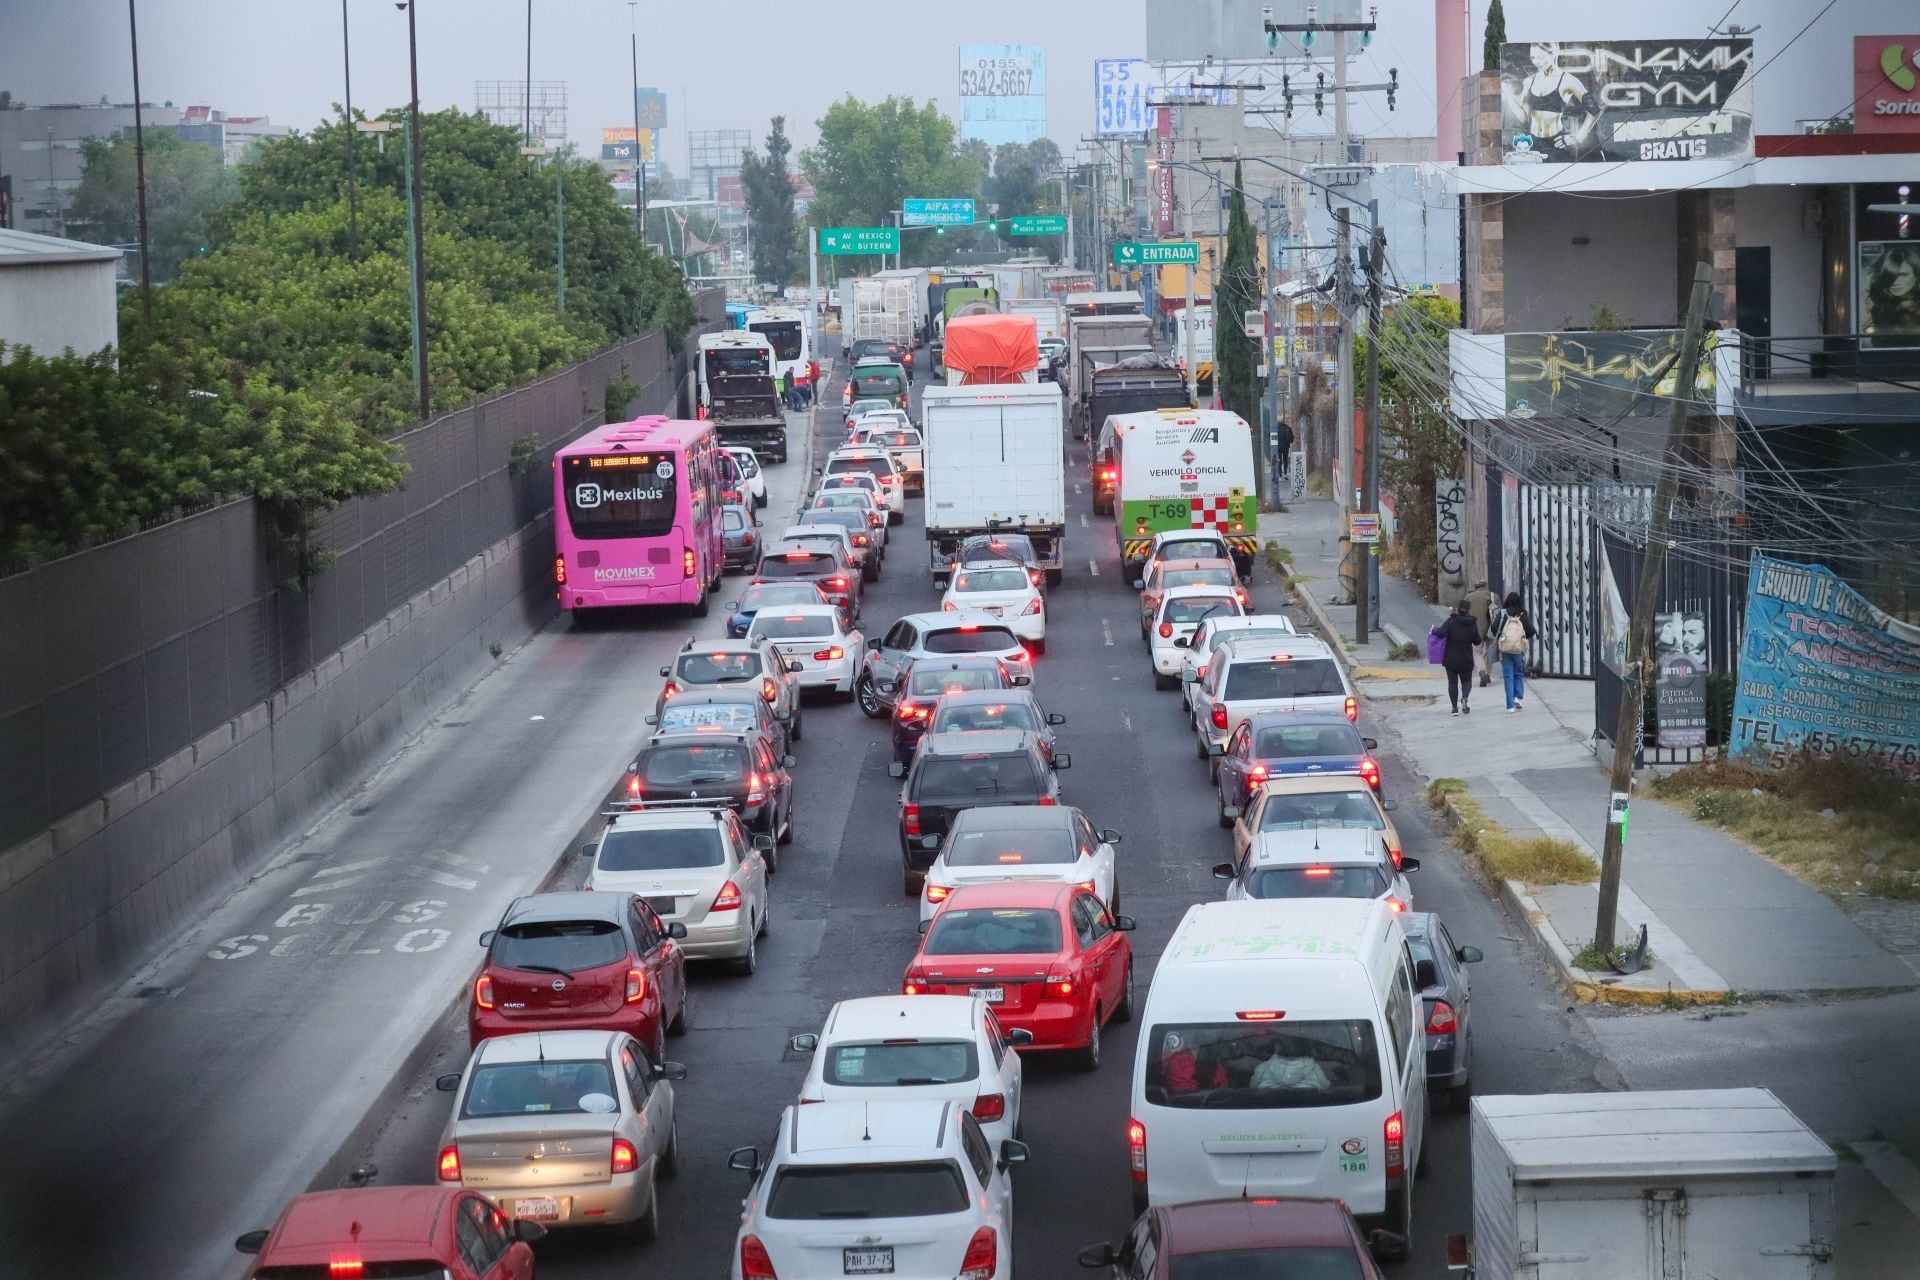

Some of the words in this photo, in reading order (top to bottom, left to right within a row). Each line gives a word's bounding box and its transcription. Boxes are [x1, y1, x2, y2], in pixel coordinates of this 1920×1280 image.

[961, 69, 1033, 97] 5342-6667
[1601, 81, 1717, 107] GYM
[1640, 139, 1707, 161] GRATIS
[925, 202, 950, 211] AIFA
[1143, 247, 1195, 260] ENTRADA
[1194, 466, 1228, 475] OFICIAL
[603, 486, 663, 502] Mexibús
[1148, 503, 1187, 520] T-69
[594, 566, 656, 580] MOVIMEX
[1796, 663, 1850, 681] SISTEMA
[1854, 674, 1871, 685] DE
[1659, 696, 1666, 705] &
[1667, 719, 1675, 727] 55
[1826, 714, 1884, 734] EXPRESS
[1887, 723, 1905, 736] EN
[274, 899, 450, 928] BUS
[206, 928, 453, 960] SOLO
[1341, 1162, 1366, 1172] 188
[845, 1254, 893, 1267] PAH-37-75
